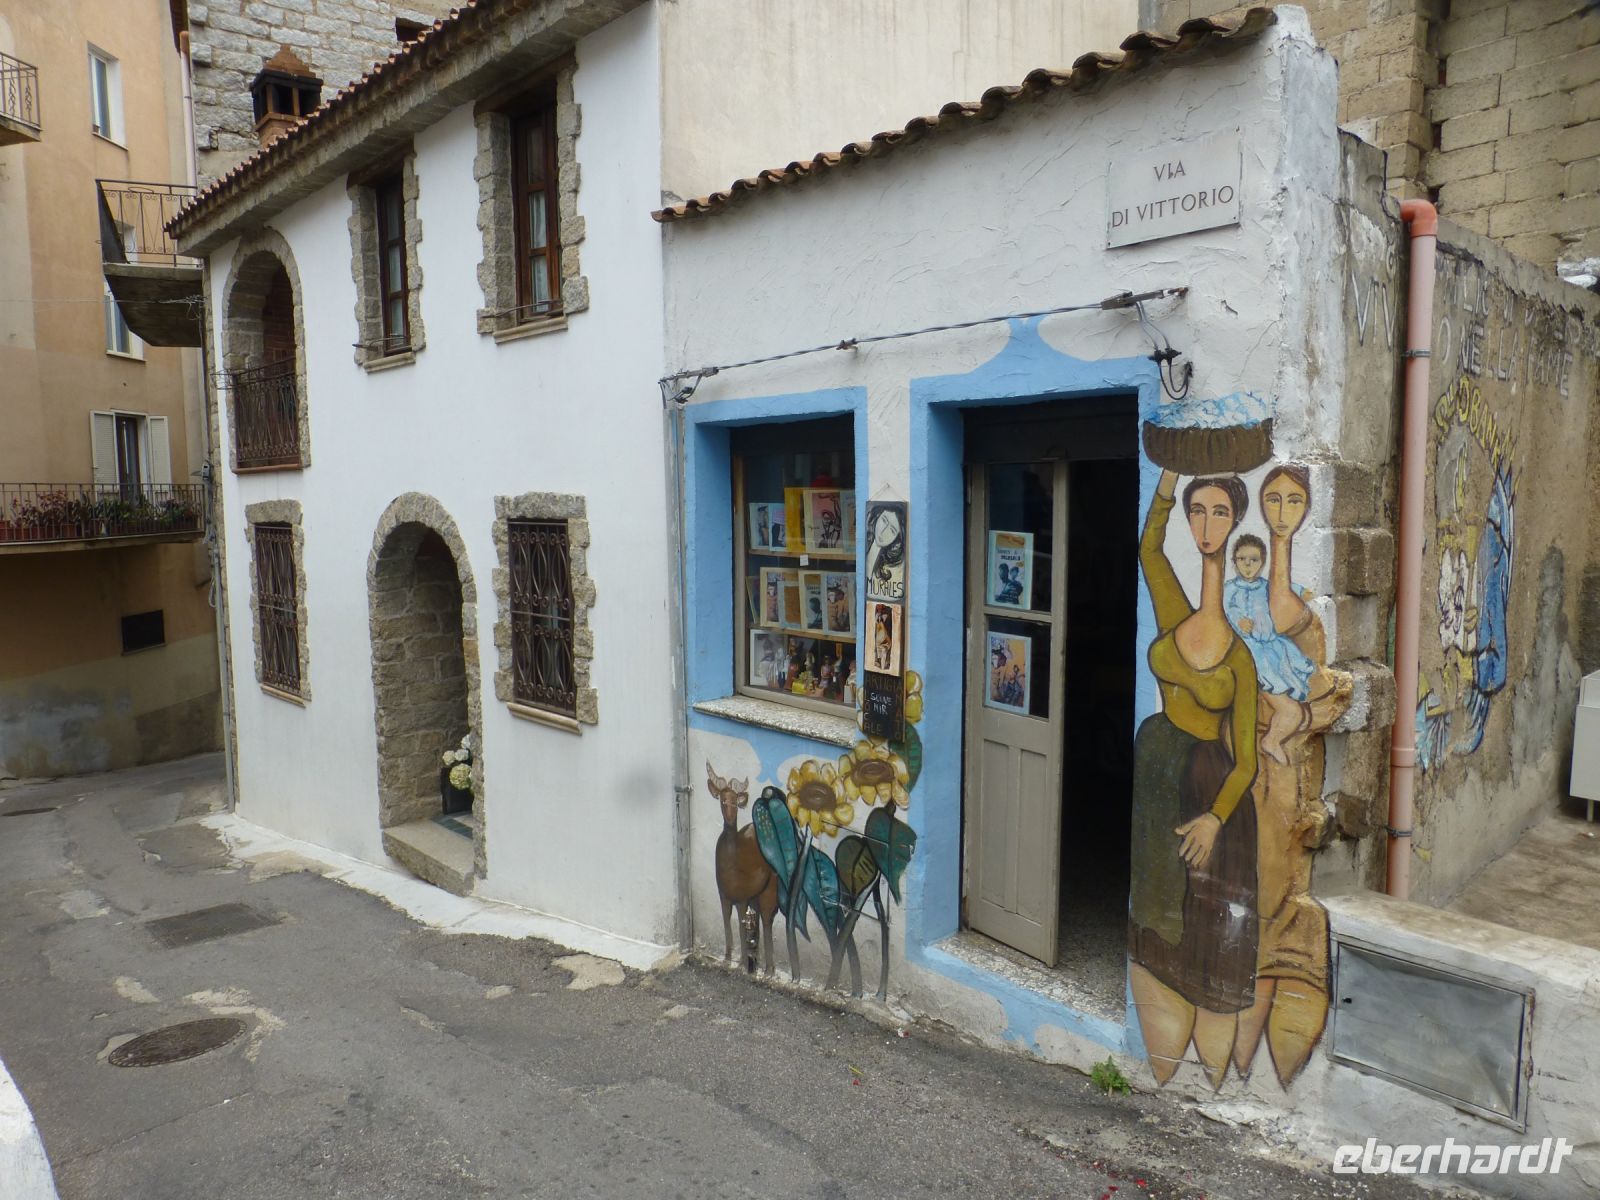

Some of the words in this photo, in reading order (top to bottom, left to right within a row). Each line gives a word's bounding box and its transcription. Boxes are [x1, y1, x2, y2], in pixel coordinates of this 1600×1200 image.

[1153, 159, 1187, 182] VIA
[1111, 208, 1130, 229] DI
[1135, 184, 1235, 222] VITTORIO
[866, 576, 905, 599] MURALES
